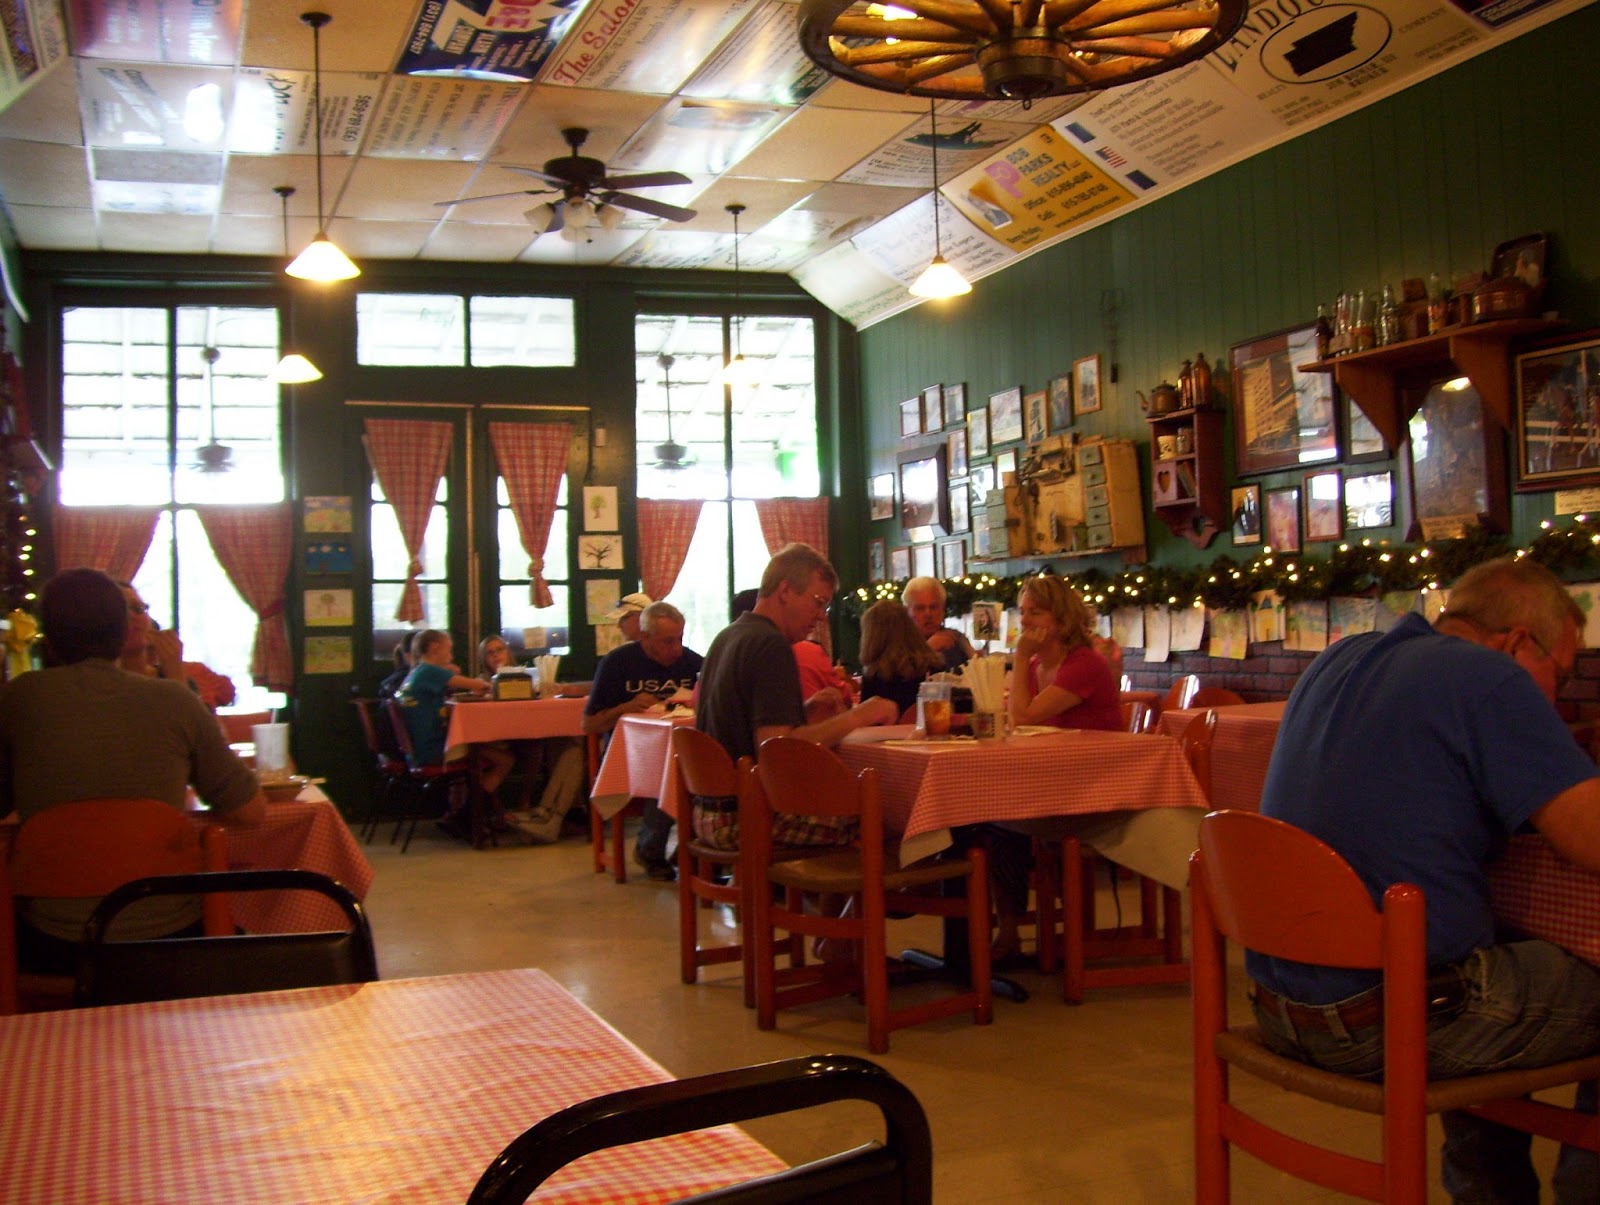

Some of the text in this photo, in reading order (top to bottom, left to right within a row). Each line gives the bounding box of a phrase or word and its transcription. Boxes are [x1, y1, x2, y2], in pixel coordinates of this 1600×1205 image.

[553, 53, 594, 81] The
[1006, 147, 1030, 165] BOB
[1018, 153, 1053, 176] PARKS
[1030, 161, 1071, 186] REALTY
